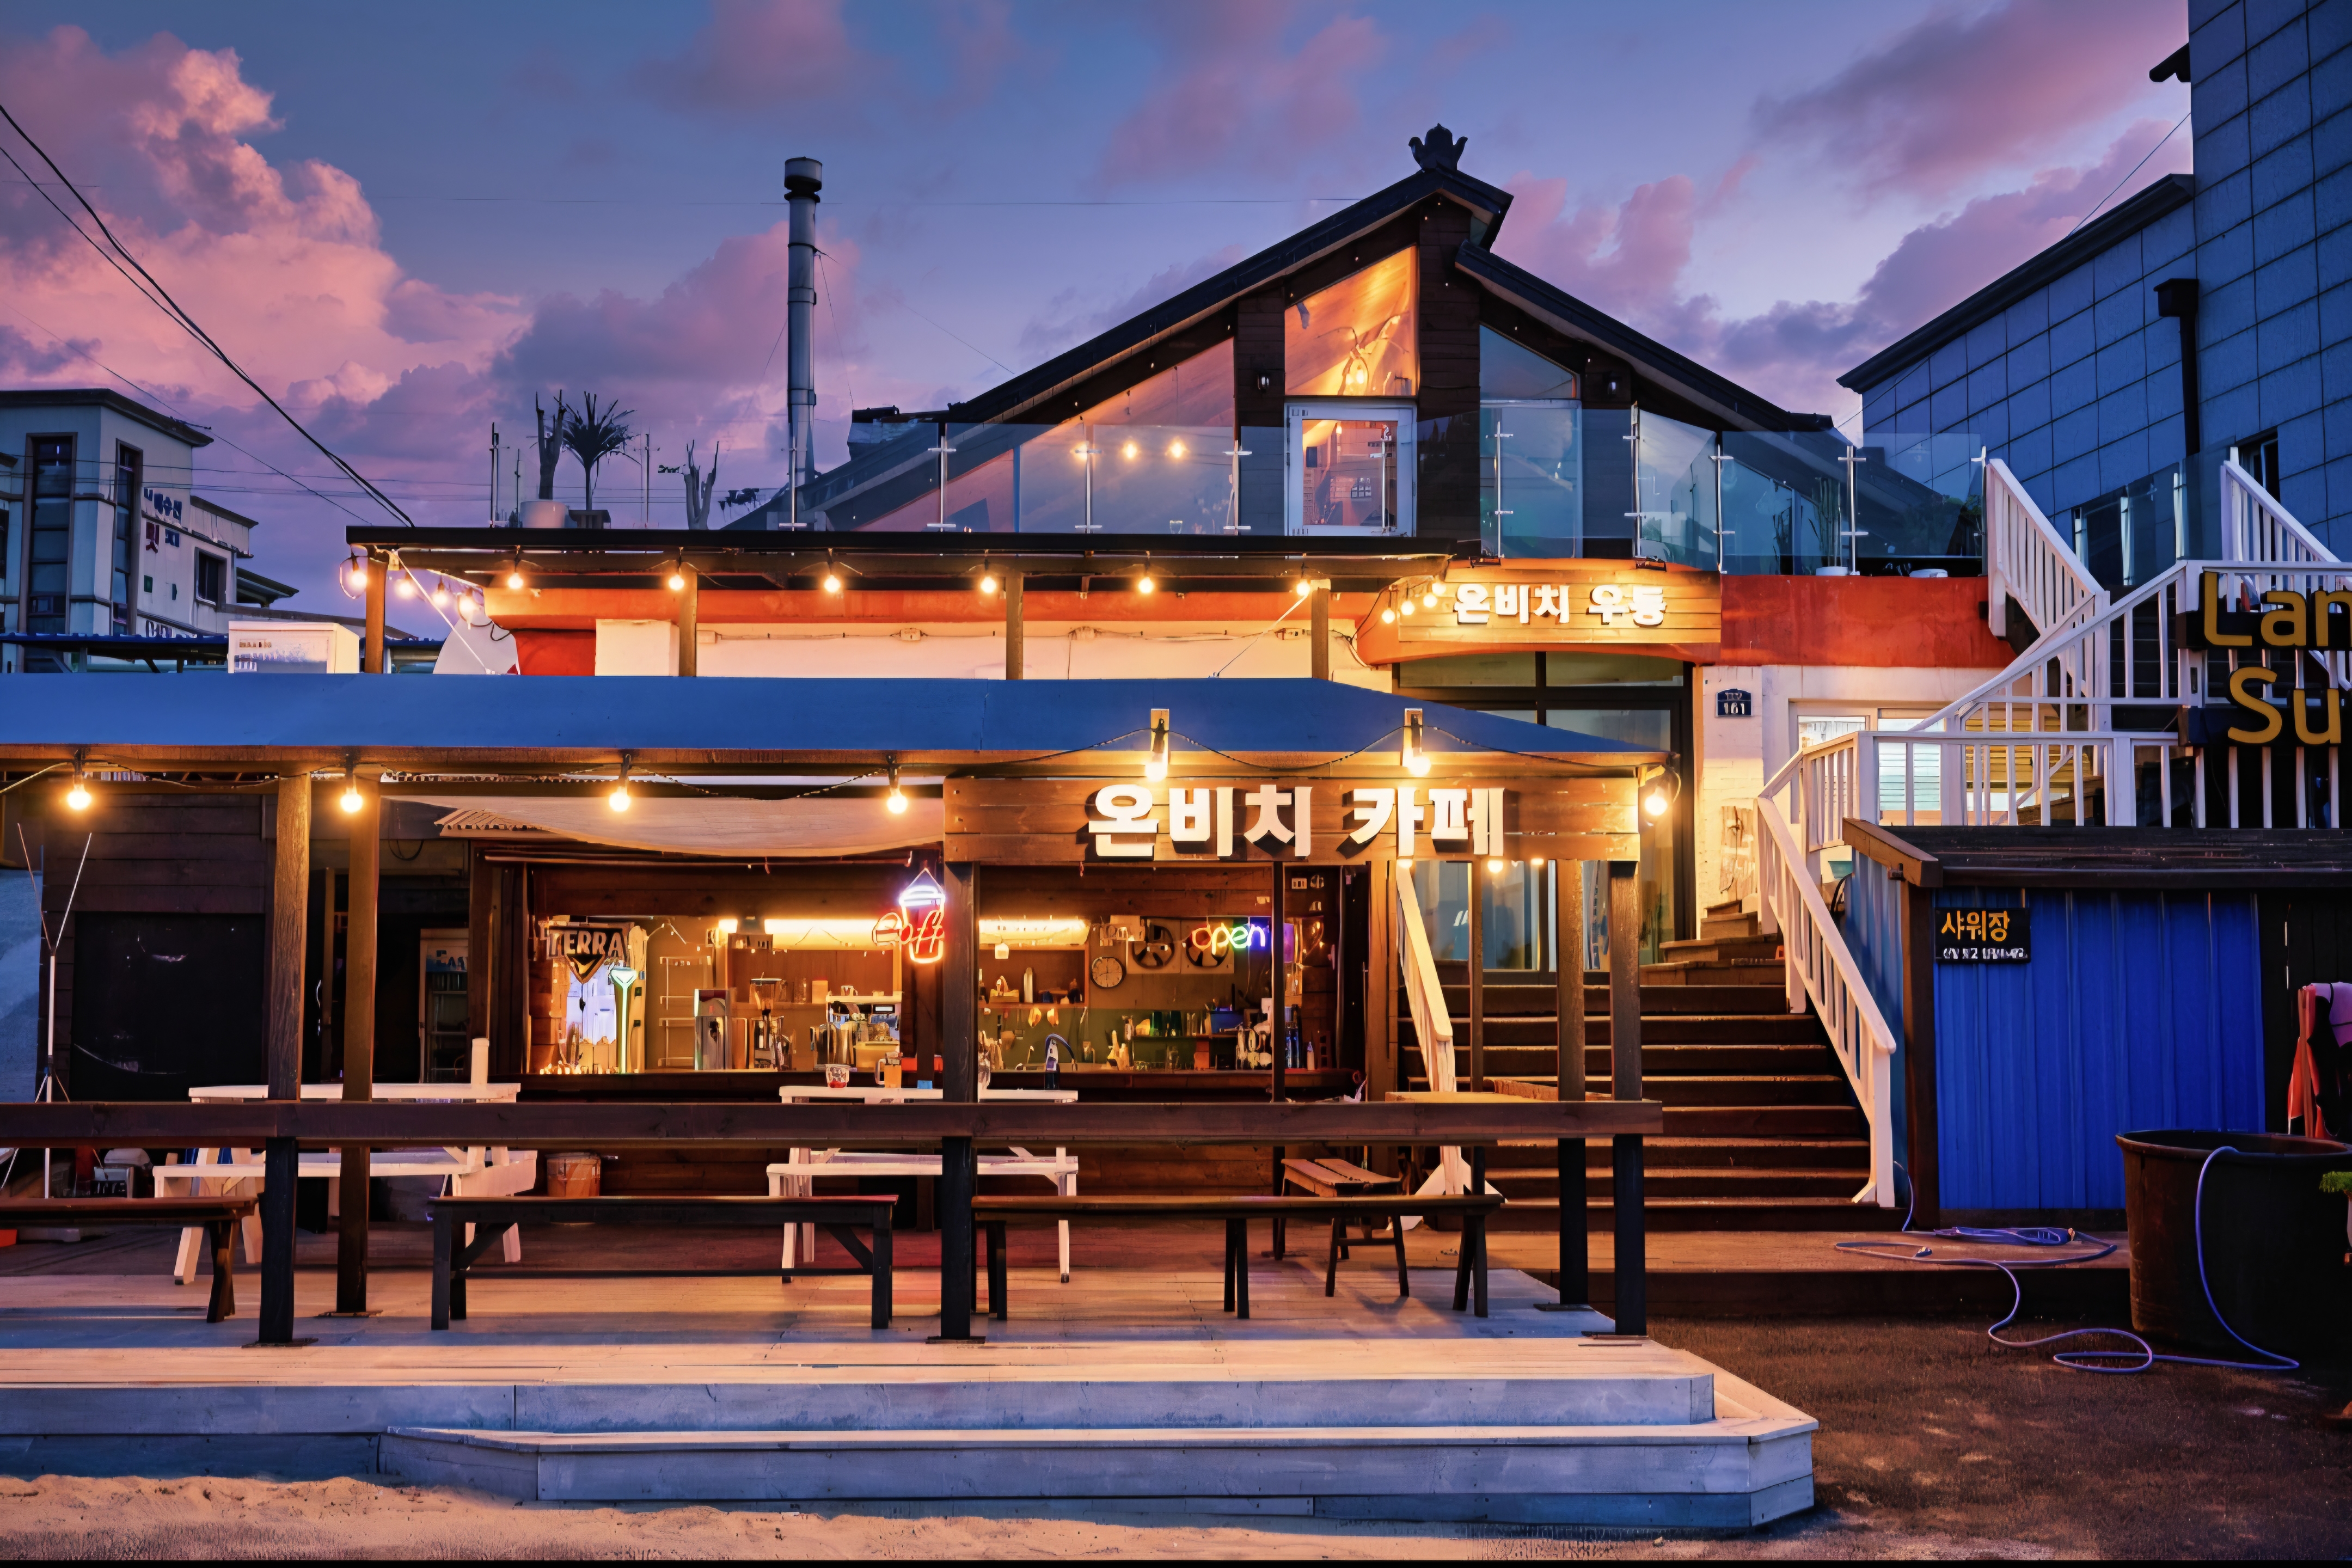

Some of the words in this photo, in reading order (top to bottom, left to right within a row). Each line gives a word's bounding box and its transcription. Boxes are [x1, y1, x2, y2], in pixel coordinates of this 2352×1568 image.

[1454, 583, 1570, 624] 온비치
[1588, 584, 1667, 626] 우동
[2228, 667, 2342, 745] Su
[1088, 784, 1313, 857] 온비치
[1349, 787, 1505, 857] 카페
[549, 929, 624, 957] TERRA
[1191, 922, 1266, 955] open
[1940, 910, 2010, 942] 샤워장
